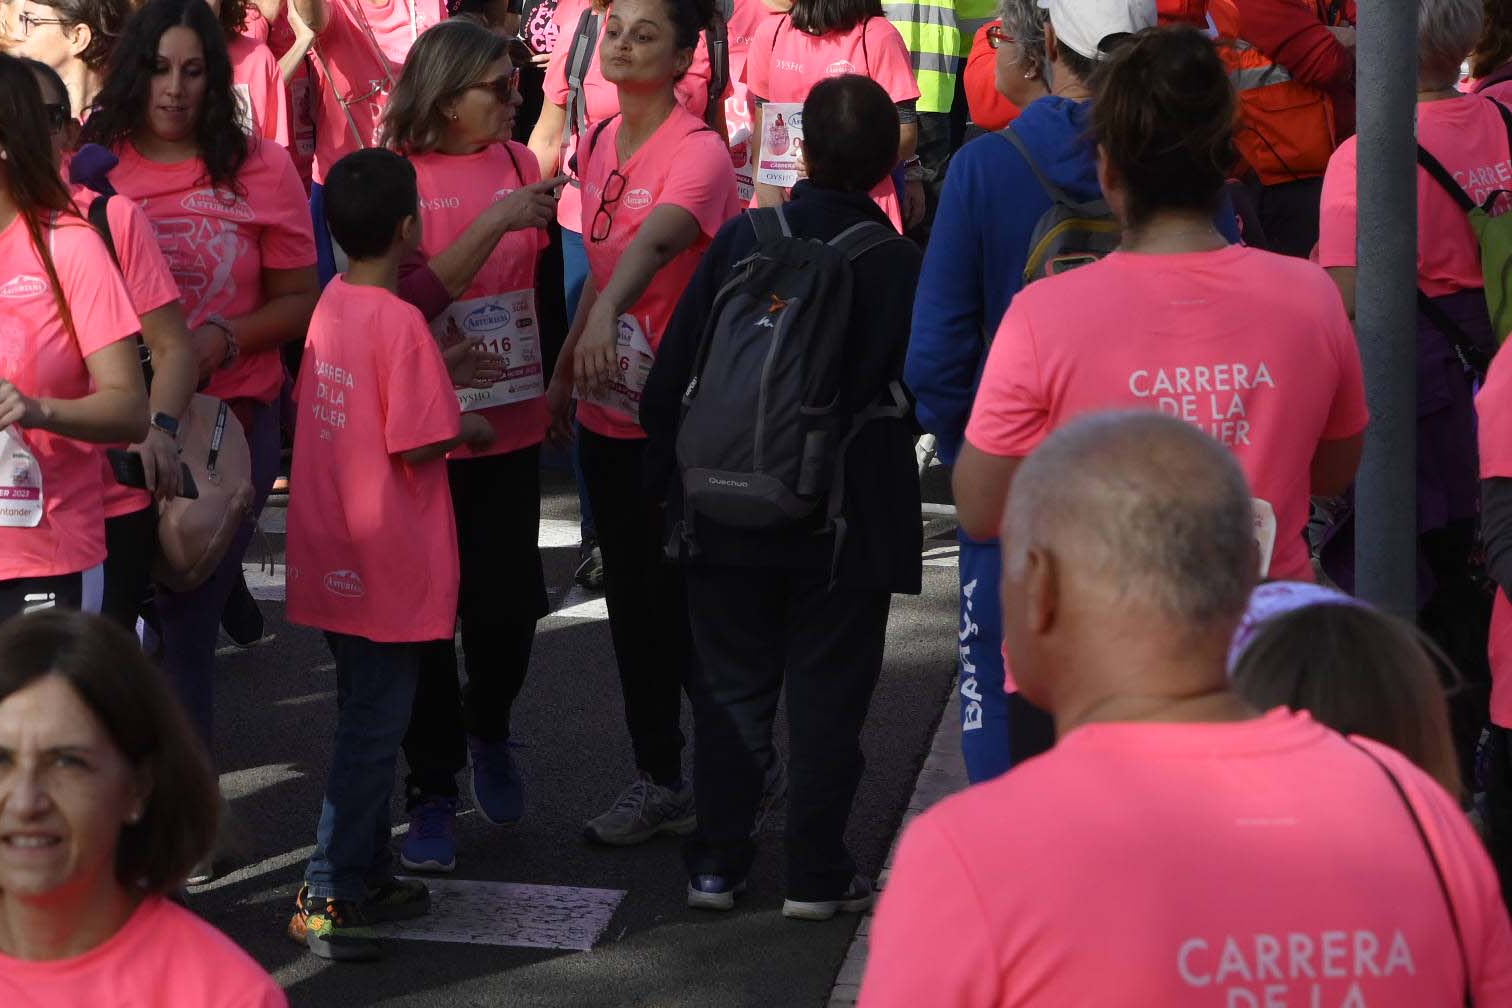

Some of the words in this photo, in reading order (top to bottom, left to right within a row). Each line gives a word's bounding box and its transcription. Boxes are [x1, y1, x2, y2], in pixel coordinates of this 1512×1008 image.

[1129, 361, 1276, 398] CARRERA
[1210, 392, 1246, 420] LA
[708, 477, 749, 488] Quechua
[1178, 929, 1417, 987] CARRERA
